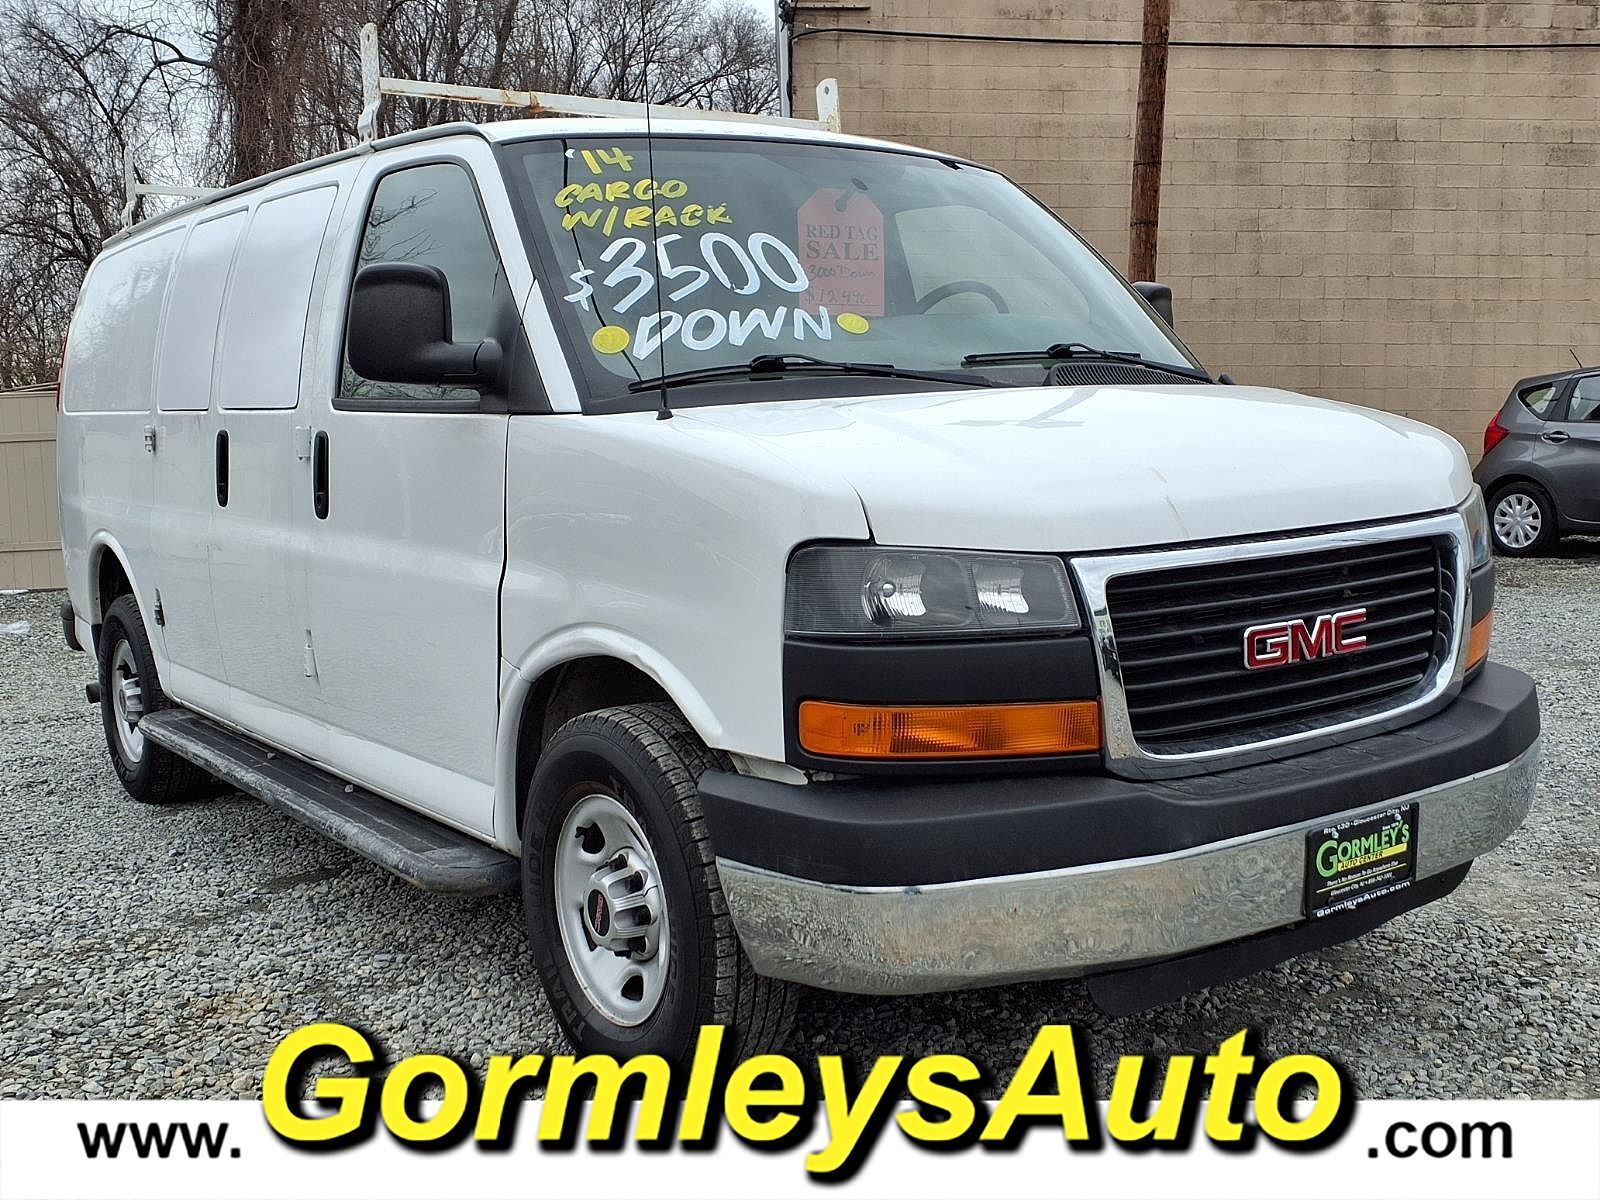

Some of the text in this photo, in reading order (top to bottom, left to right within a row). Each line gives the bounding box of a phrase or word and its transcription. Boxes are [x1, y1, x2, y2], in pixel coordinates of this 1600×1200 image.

[554, 178, 688, 208] CARGO
[561, 202, 733, 237] W/RACK
[806, 223, 878, 241] RED TAG
[806, 240, 879, 261] SALE
[563, 232, 810, 314] $3500
[632, 306, 832, 361] DOWN
[1243, 607, 1367, 671] GMC
[1316, 820, 1410, 878] GORMLEY'S
[1340, 849, 1386, 871] AUTO CENTER
[1316, 880, 1411, 919] GormleysAuto.com
